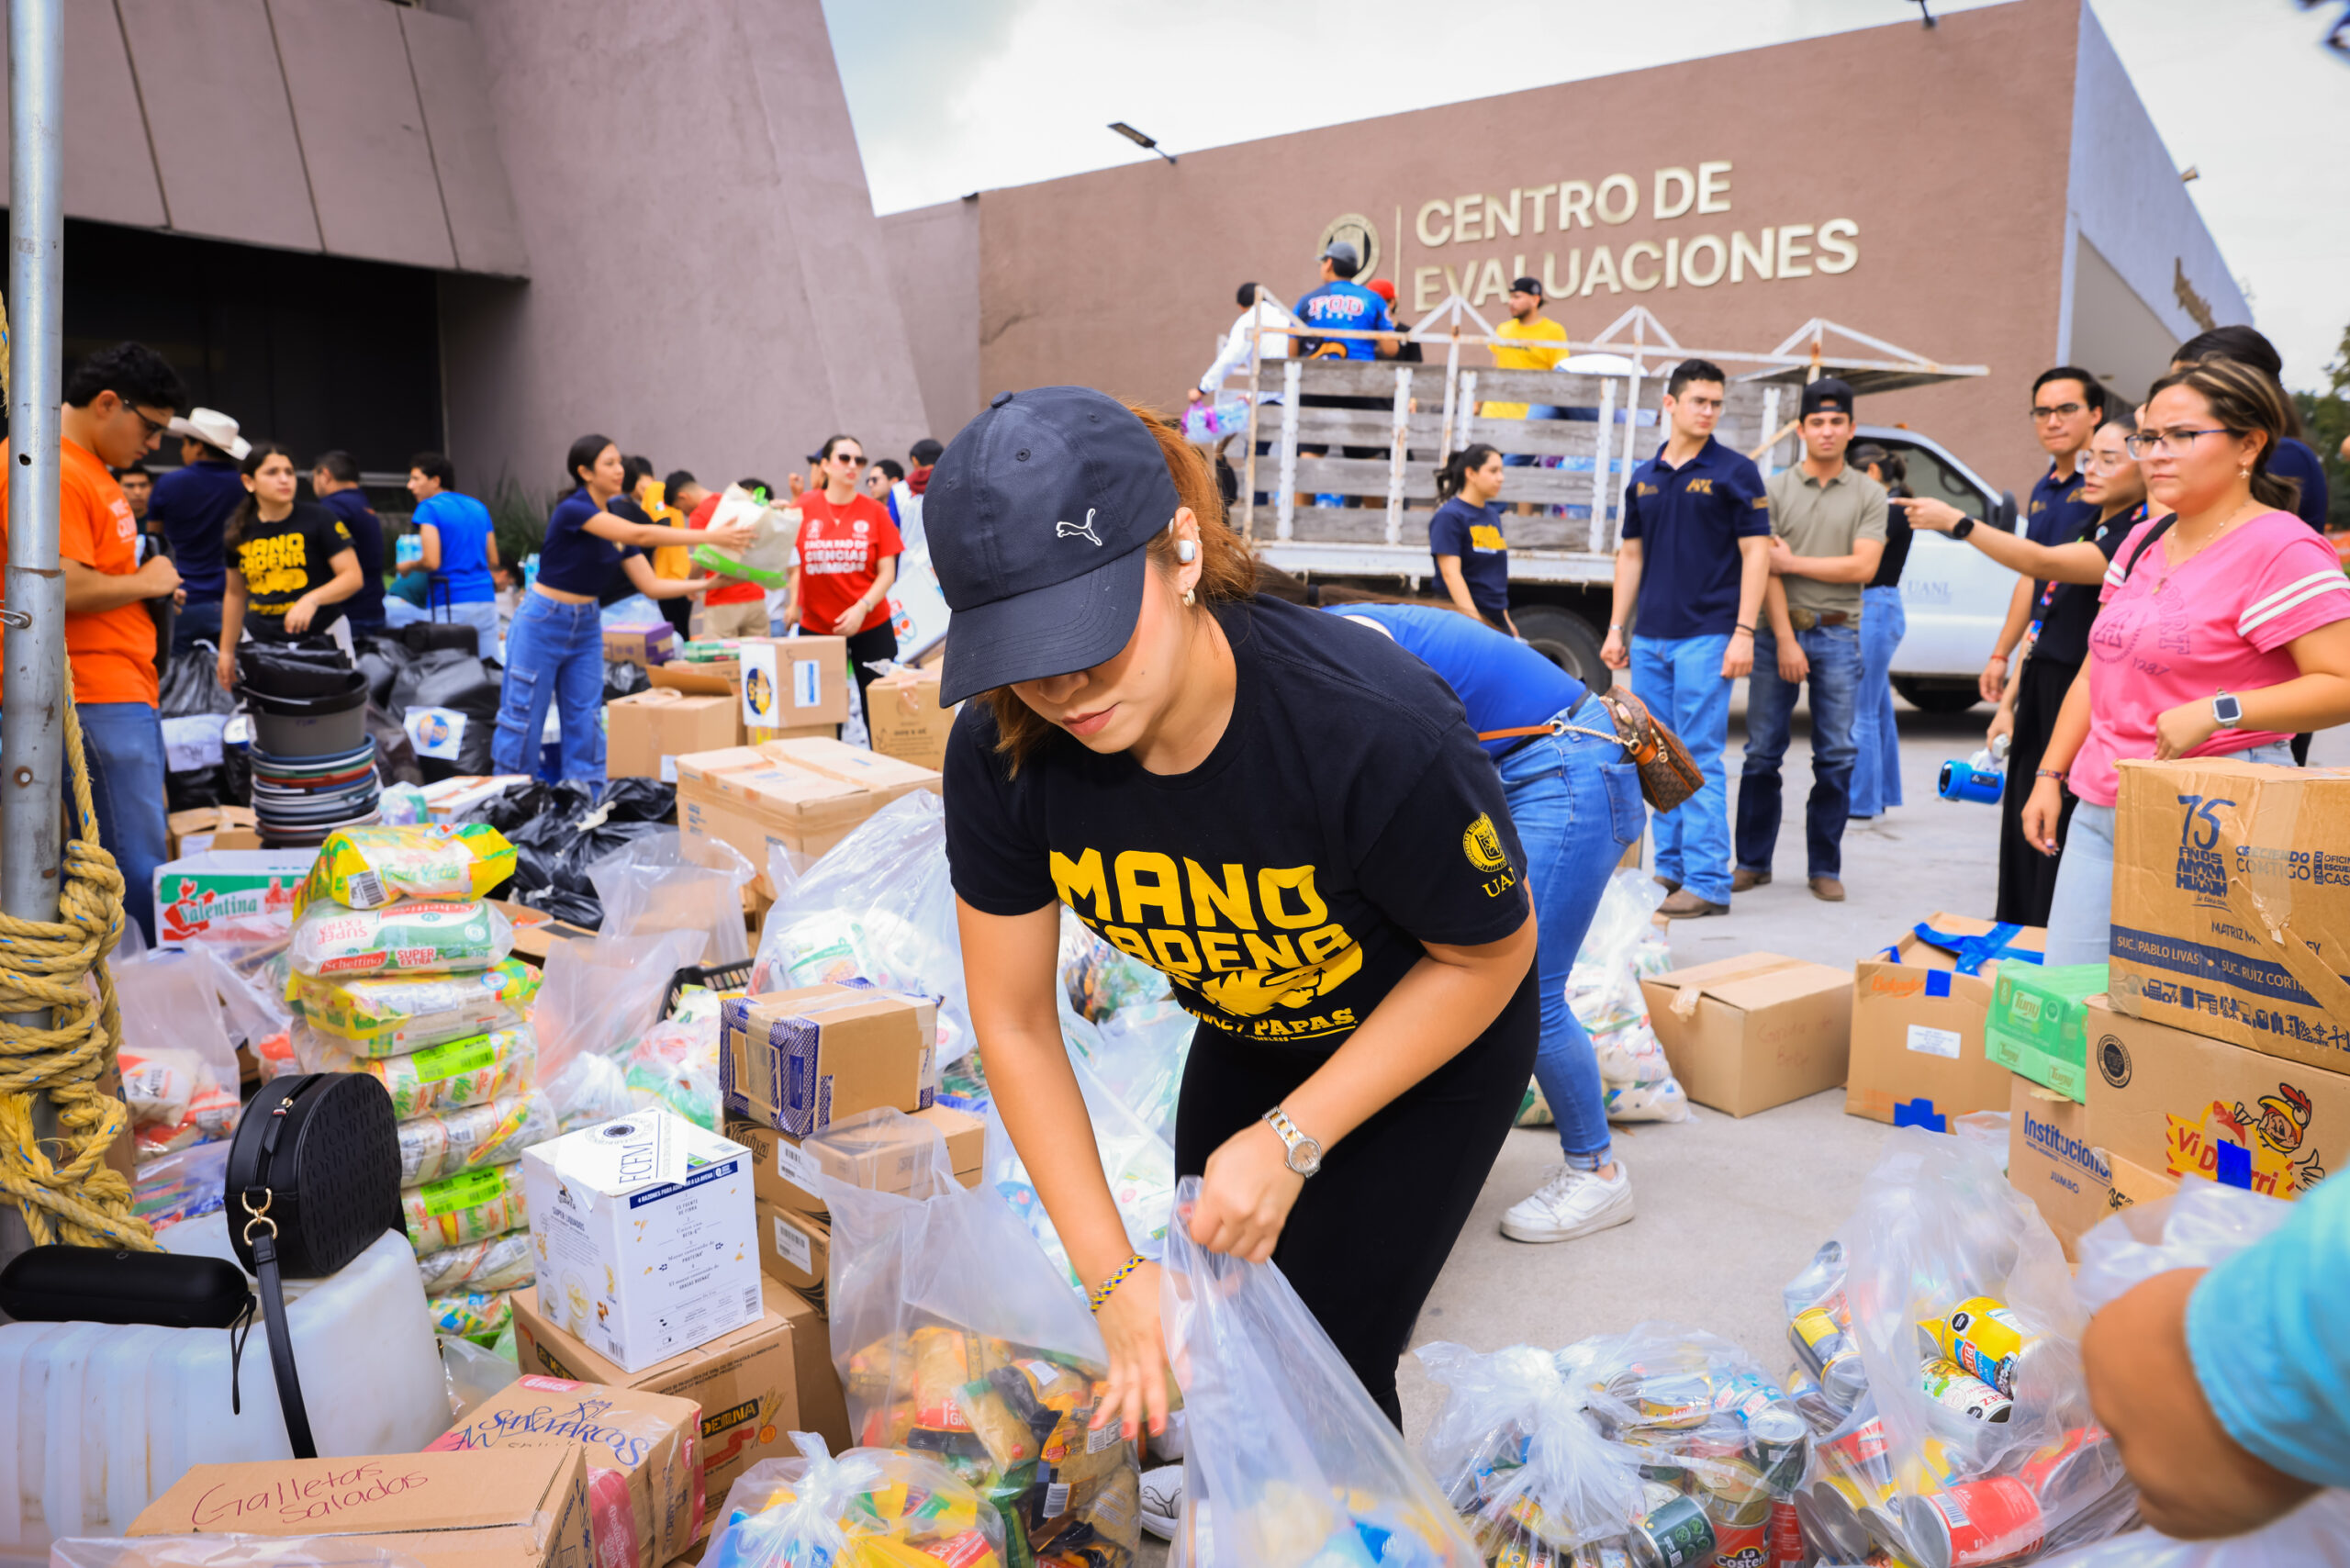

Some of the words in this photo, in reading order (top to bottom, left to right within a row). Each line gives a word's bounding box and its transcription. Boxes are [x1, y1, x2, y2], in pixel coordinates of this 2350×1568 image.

[1415, 172, 1639, 248] CENTRO
[1653, 160, 1733, 220] DE
[1415, 218, 1860, 312] EVALUACIONES
[2177, 794, 2237, 851] 75
[2178, 846, 2222, 866] AÑOS
[178, 895, 258, 924] Valentina
[1050, 847, 1328, 932] MANO
[397, 947, 435, 959] SUPER
[1074, 910, 1354, 975] ADENA
[2117, 935, 2137, 951] SUC.
[2138, 941, 2170, 958] PABLO
[2172, 947, 2199, 966] LIVAS
[2211, 921, 2244, 942] MATRIZ
[2221, 959, 2241, 978] SUC.
[2242, 965, 2264, 982] RUIZ
[619, 1141, 653, 1184] FCFM
[191, 1462, 383, 1526] Galletas
[278, 1470, 429, 1524] saladas
[1741, 1548, 1755, 1559] La
